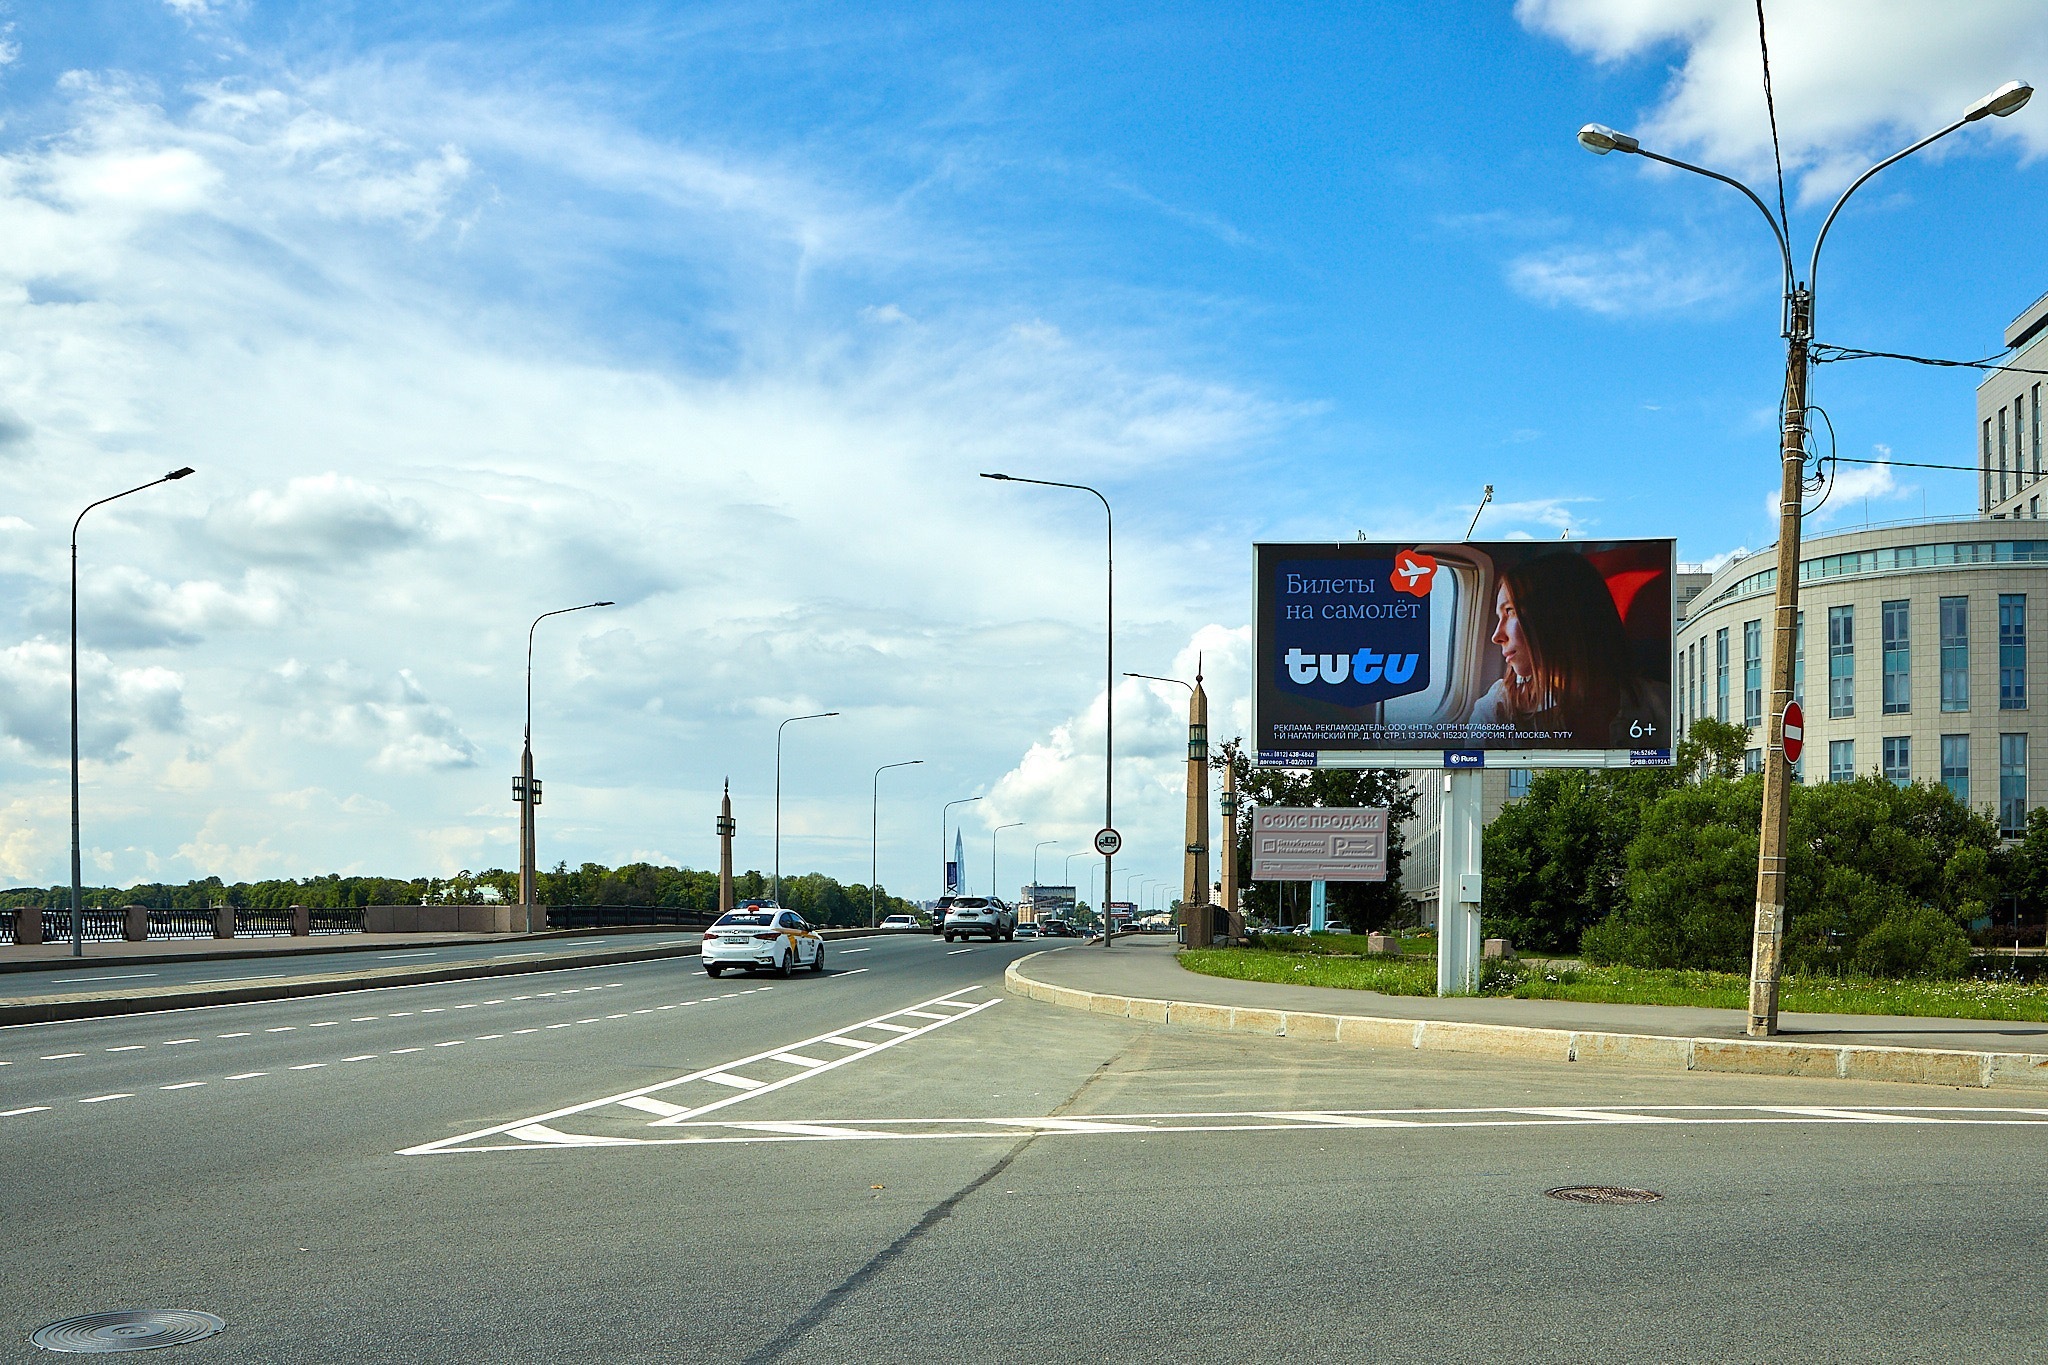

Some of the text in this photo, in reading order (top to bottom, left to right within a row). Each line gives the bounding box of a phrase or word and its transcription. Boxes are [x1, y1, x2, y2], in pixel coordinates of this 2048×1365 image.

[1286, 573, 1375, 594] Билеты
[1286, 599, 1421, 620] на самолёт
[1284, 647, 1419, 685] tutu
[1273, 723, 1313, 732] РЕКЛАМА.
[1315, 723, 1387, 732] РЕКЛАМОДАТЕЛЬ:
[1388, 723, 1407, 731] ООО
[1436, 723, 1458, 731] ОГРН
[1459, 723, 1517, 732] 1147746826468,
[1287, 730, 1346, 740] НАГАТИНСКИЙ
[1408, 731, 1416, 739] 13
[1442, 731, 1469, 740] 115230,
[1471, 731, 1507, 740] РОССИЯ,
[1553, 731, 1573, 739] ТУТУ
[1629, 719, 1657, 739] 6+
[1261, 814, 1379, 831] ОФИС ПРОДАЖ
